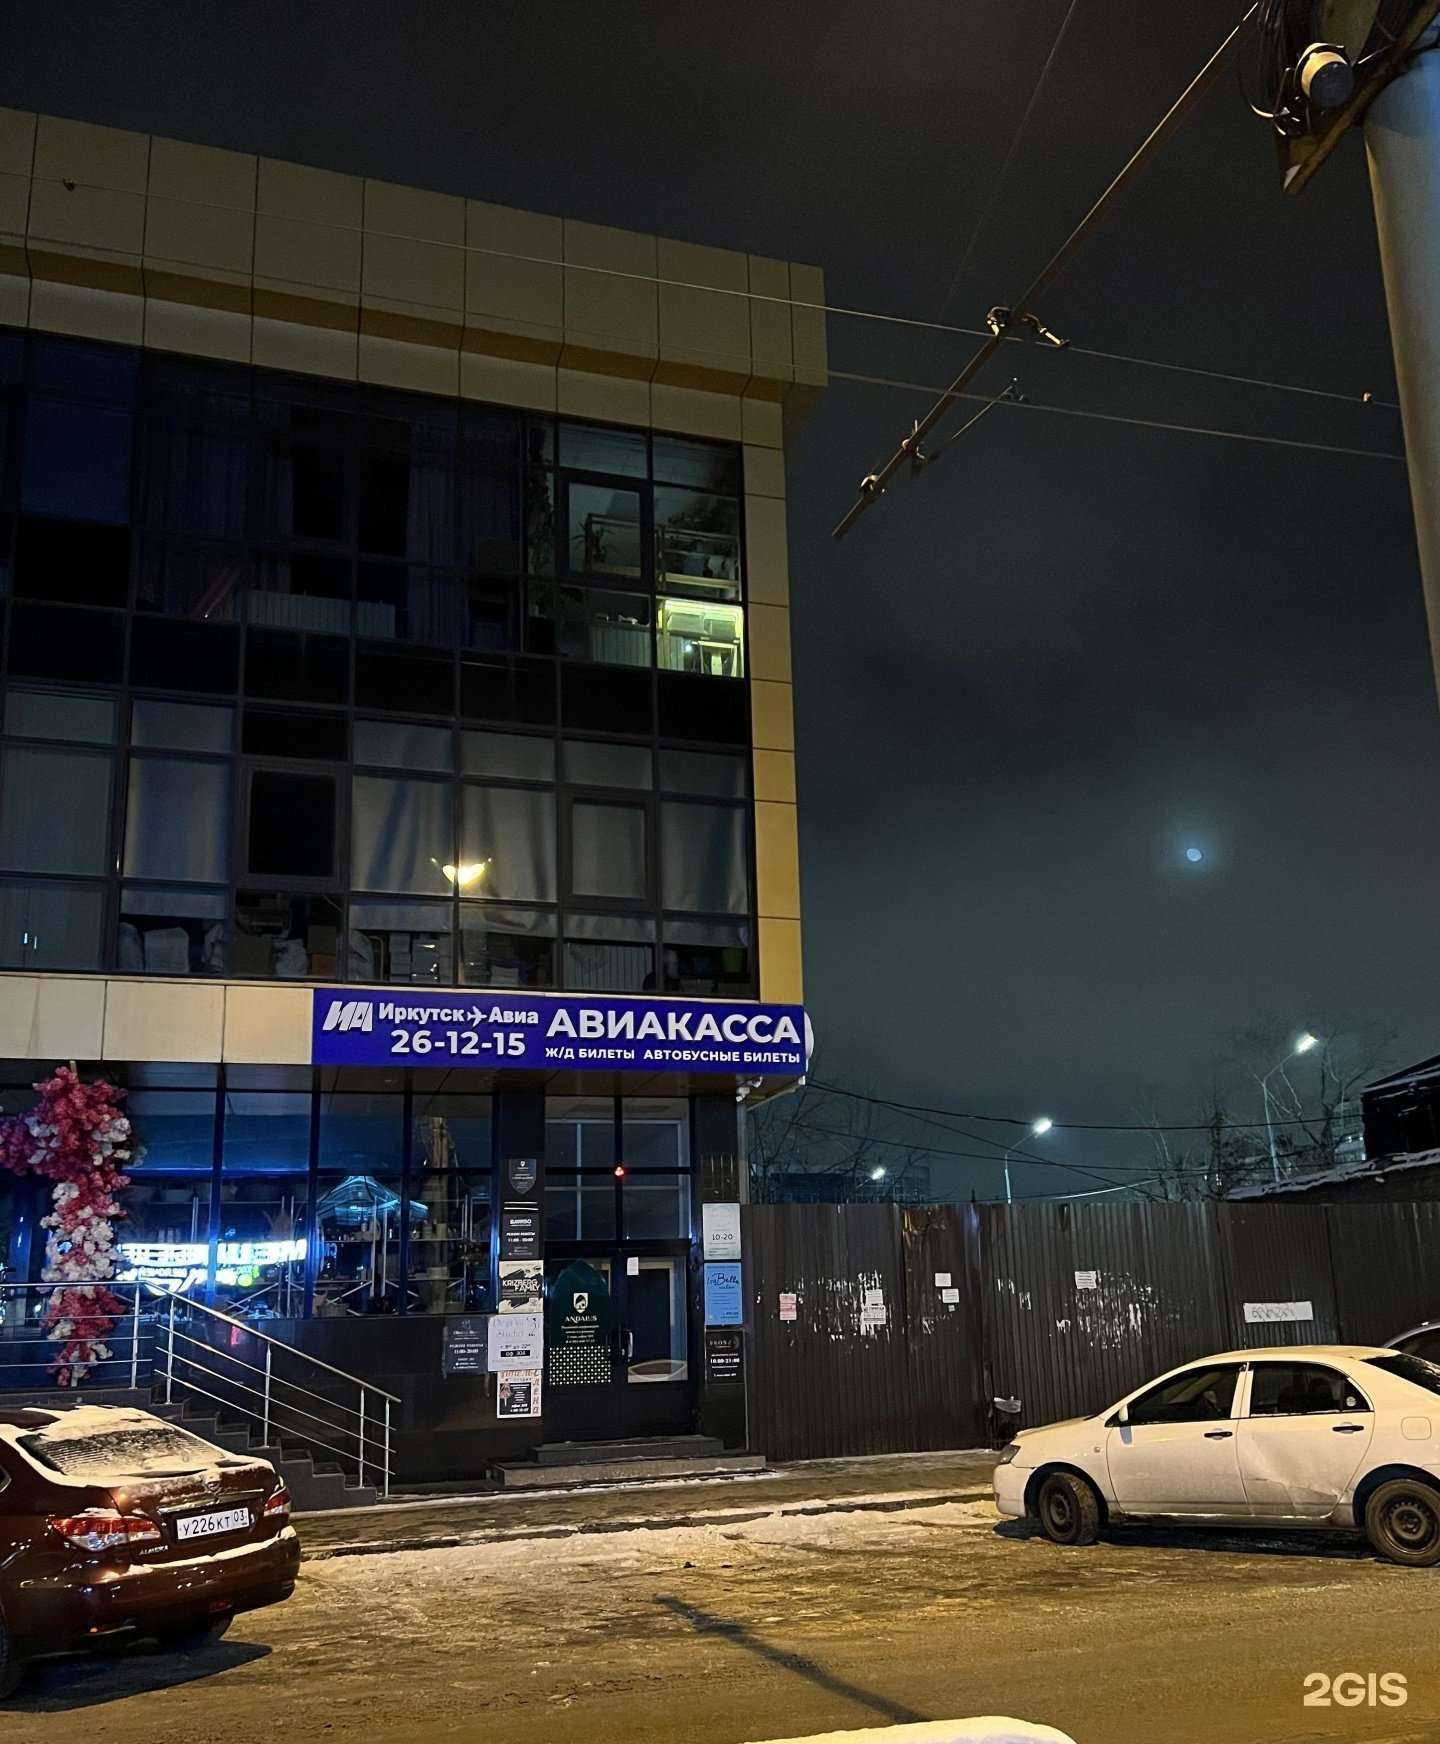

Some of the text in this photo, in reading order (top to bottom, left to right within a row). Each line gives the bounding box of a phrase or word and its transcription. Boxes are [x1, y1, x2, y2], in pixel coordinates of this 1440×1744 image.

[378, 1002, 539, 1025] Иркутск Авиа
[546, 1008, 801, 1044] АВИАКАССА
[391, 1029, 526, 1056] 26-12-15
[545, 1047, 800, 1064] Ж/Д БИЛЕТЫ АВТОБУСНЫЕ БИЛЕТЫ
[183, 1511, 245, 1535] У226КТ 03
